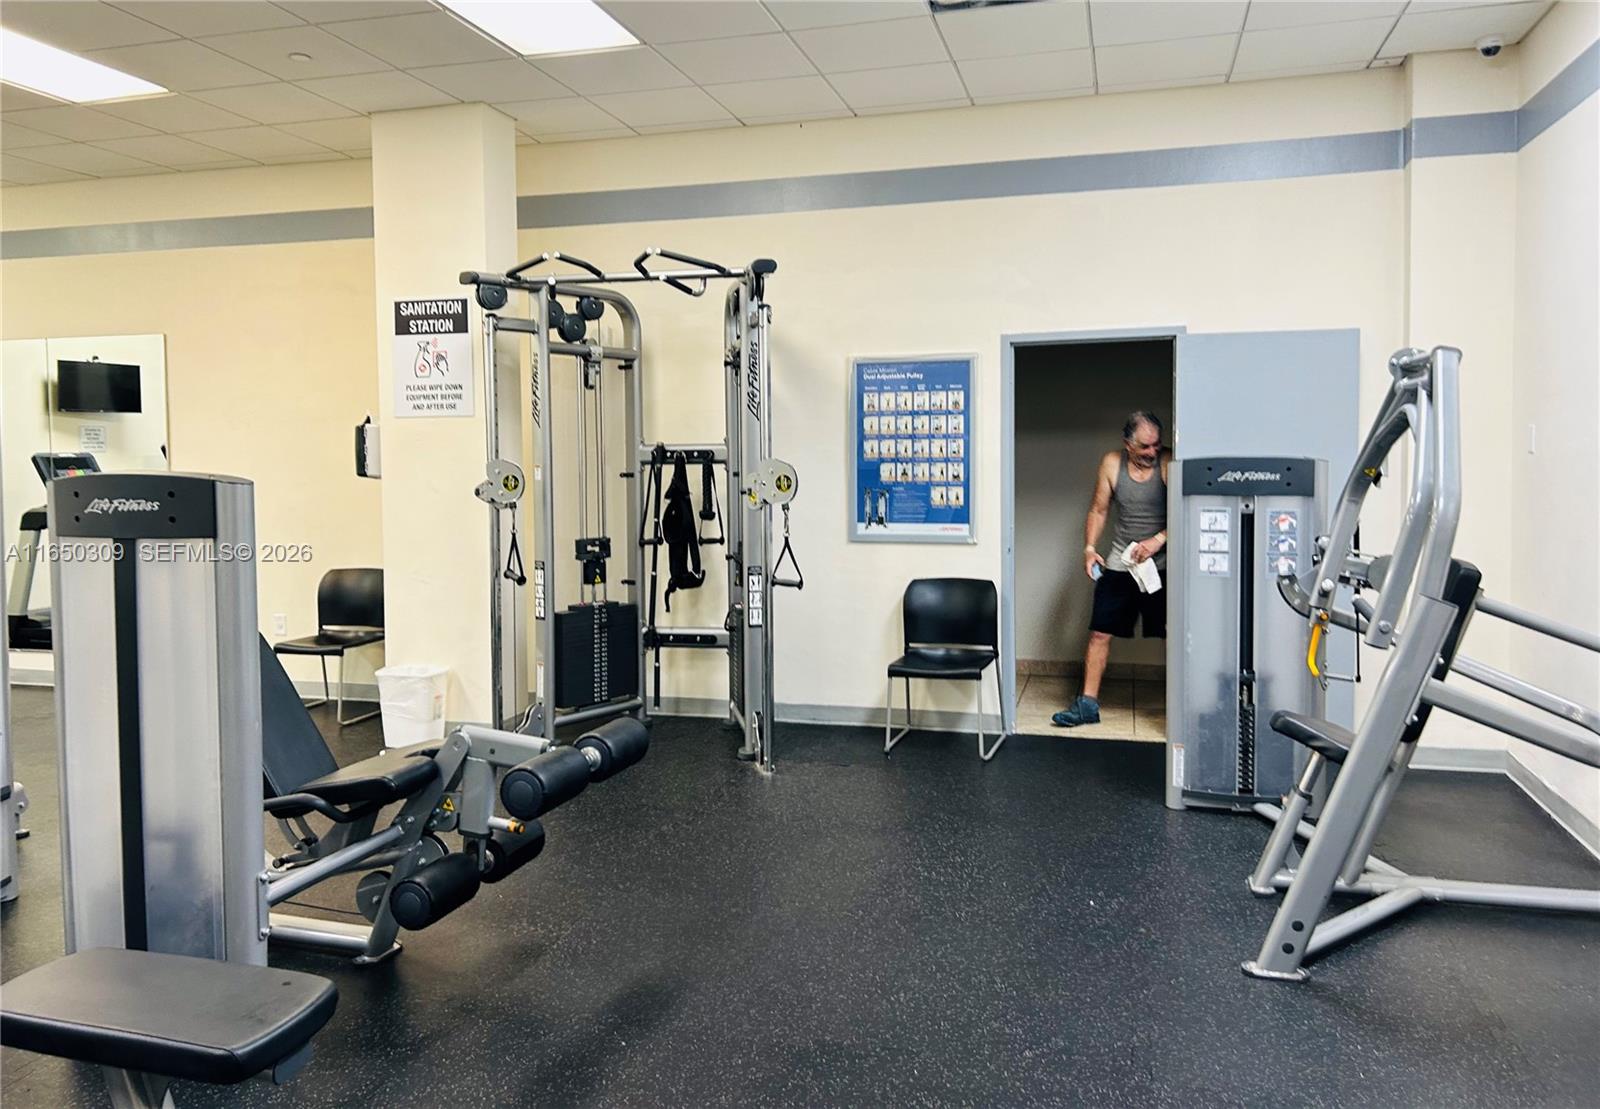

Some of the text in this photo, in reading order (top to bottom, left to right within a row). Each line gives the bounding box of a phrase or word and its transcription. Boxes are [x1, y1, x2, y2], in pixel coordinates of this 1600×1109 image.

[400, 301, 462, 316] SANITATION
[409, 319, 453, 333] STATION
[428, 383, 443, 391] WIPE
[444, 383, 463, 391] DOWN
[406, 393, 438, 401] EQUIPMENT
[426, 402, 444, 410] AFTER
[445, 402, 457, 410] USE
